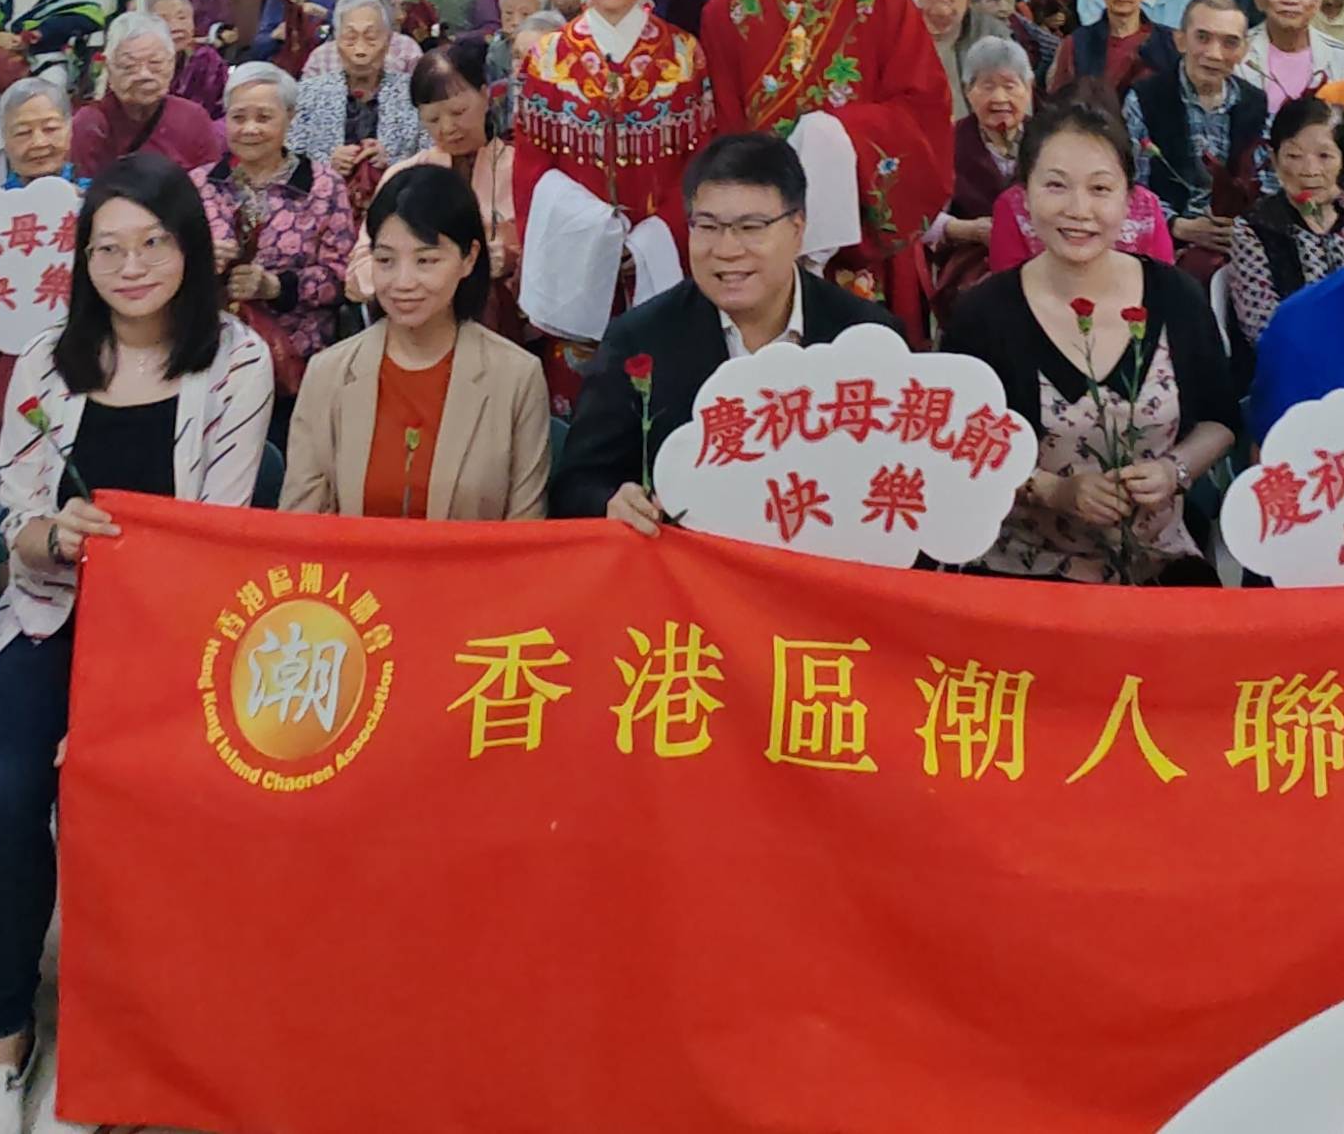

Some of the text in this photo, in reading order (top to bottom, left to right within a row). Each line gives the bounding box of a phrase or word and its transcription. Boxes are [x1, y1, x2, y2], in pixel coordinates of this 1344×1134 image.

[695, 378, 1022, 479] 慶祝母親節
[763, 464, 928, 543] 快樂
[215, 736, 263, 785] Island
